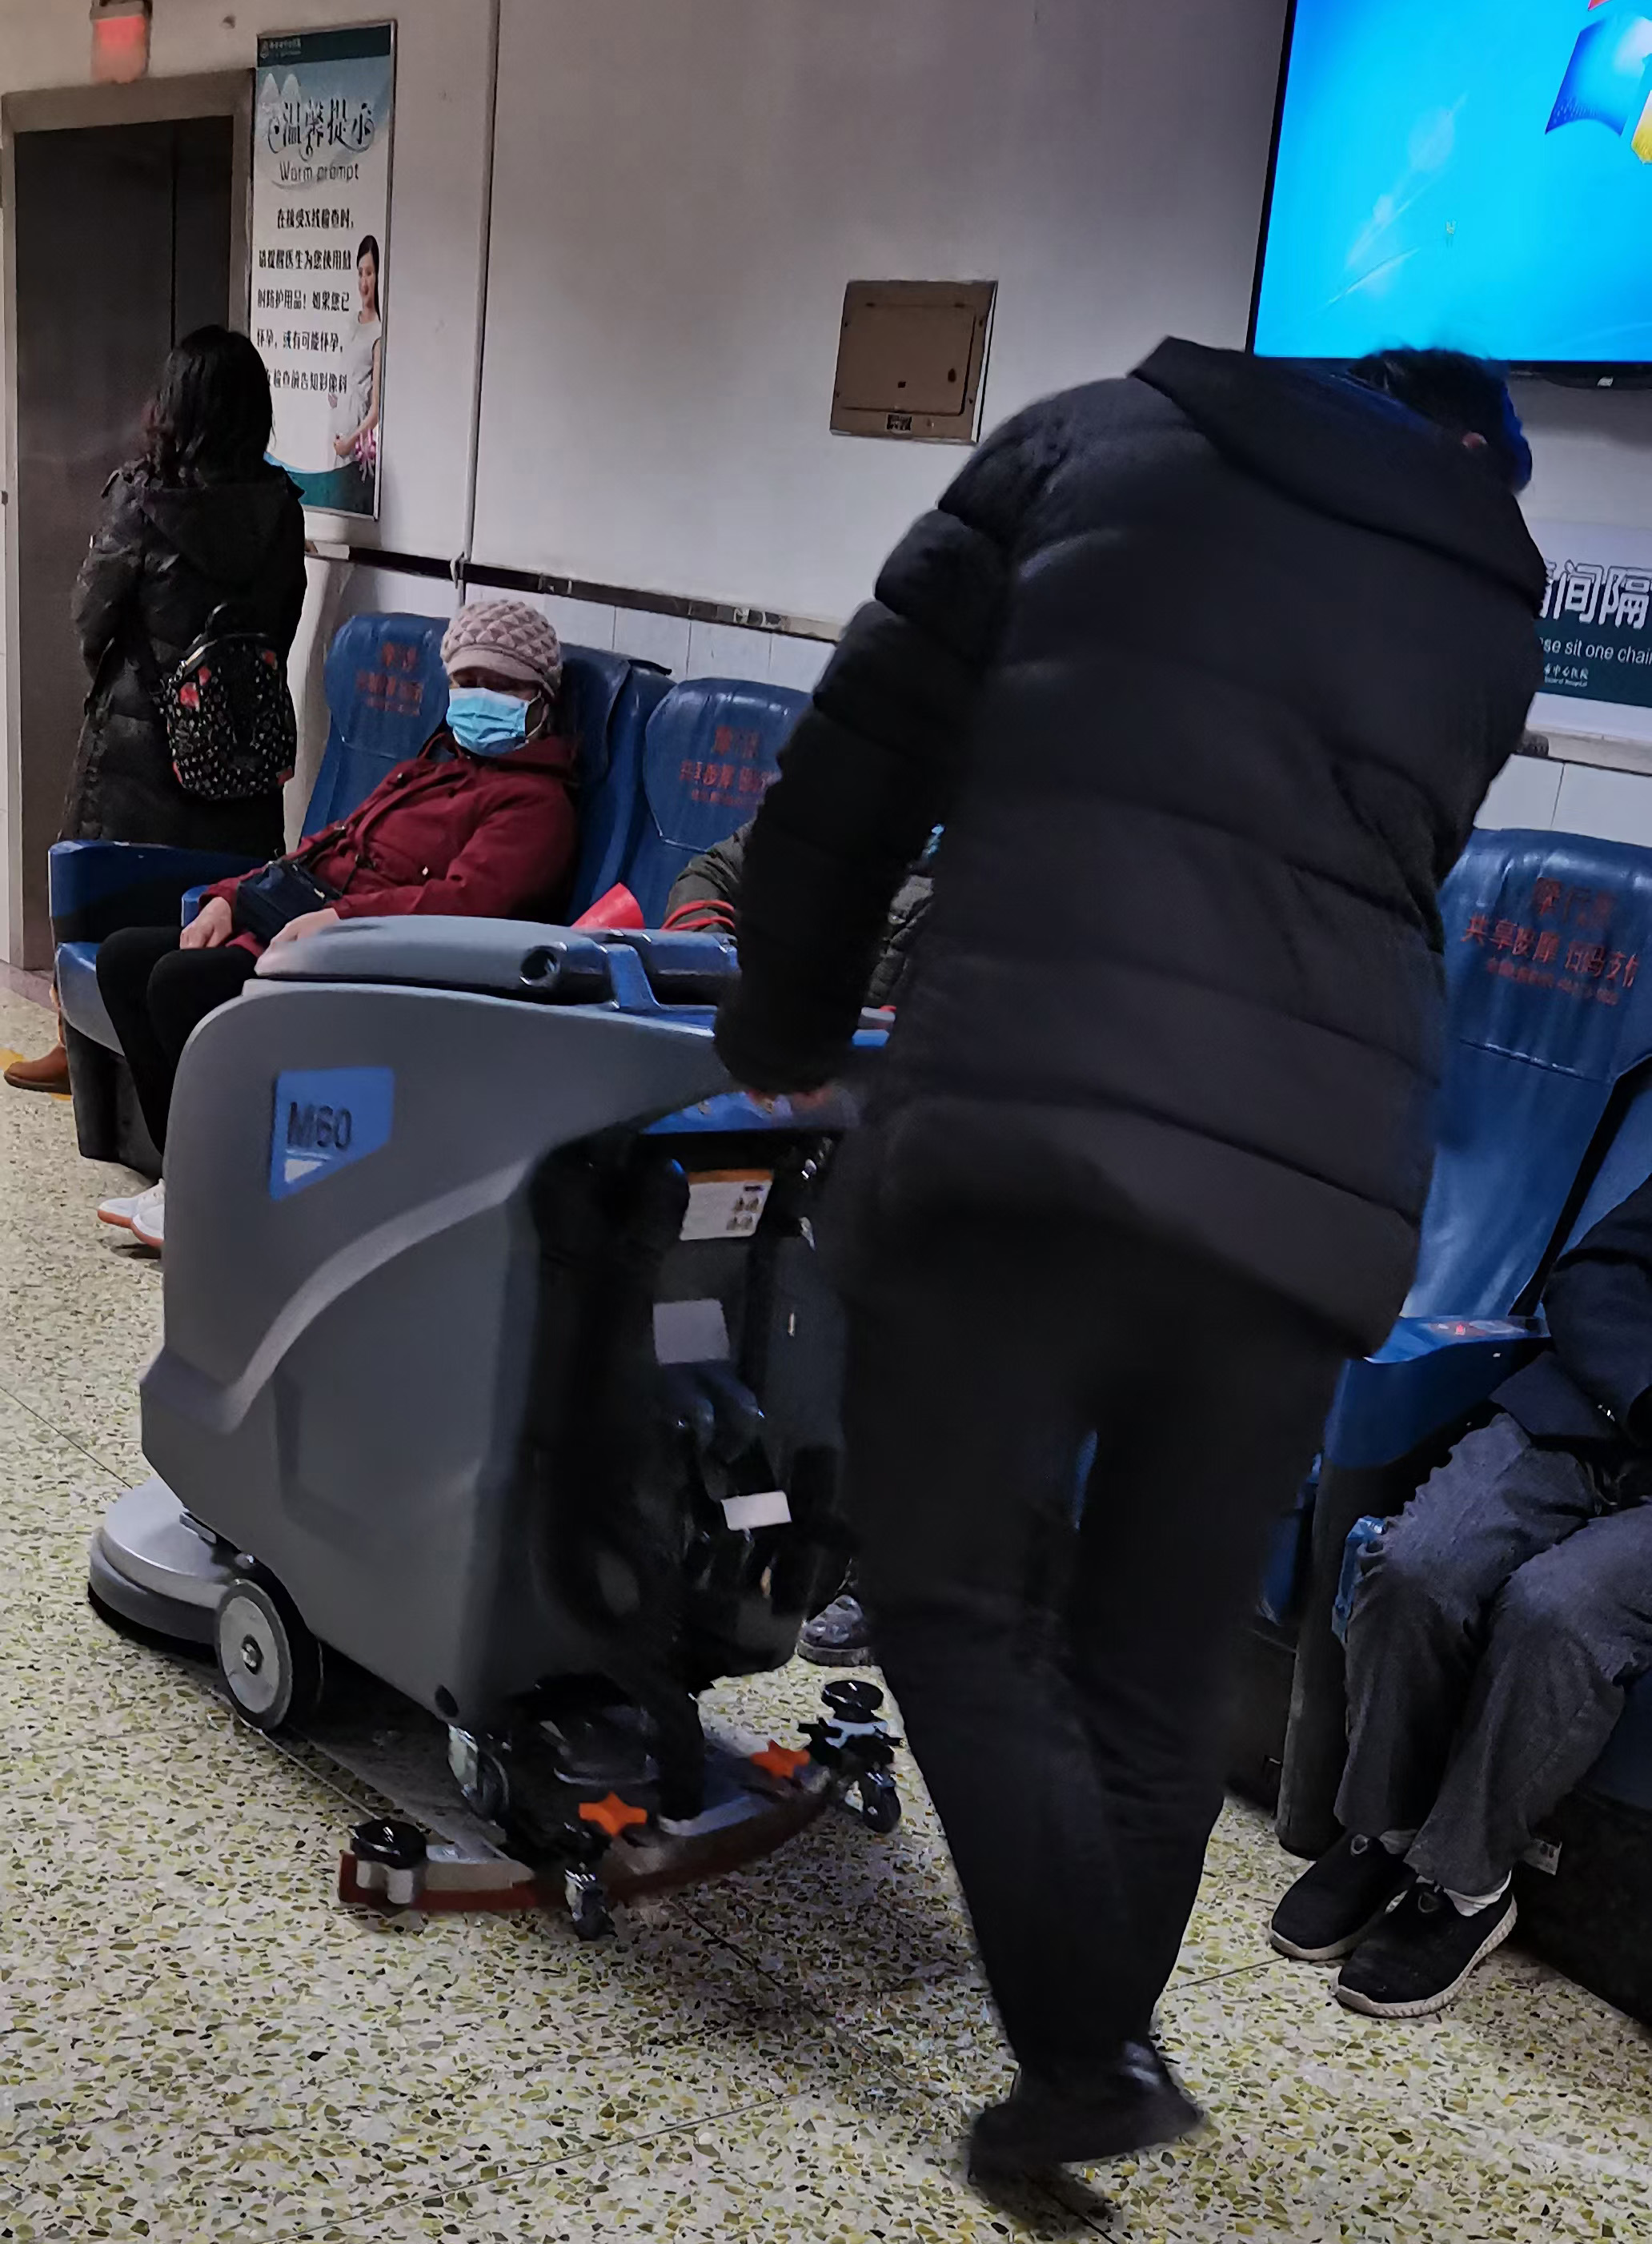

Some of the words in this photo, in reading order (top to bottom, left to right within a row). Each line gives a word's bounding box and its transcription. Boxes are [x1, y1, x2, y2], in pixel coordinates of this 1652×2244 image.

[279, 162, 313, 181] Warm
[317, 163, 359, 183] prompt
[1540, 560, 1651, 630] 间隔
[1539, 637, 1562, 654] se
[1564, 639, 1582, 658] sit
[1585, 644, 1614, 660] one
